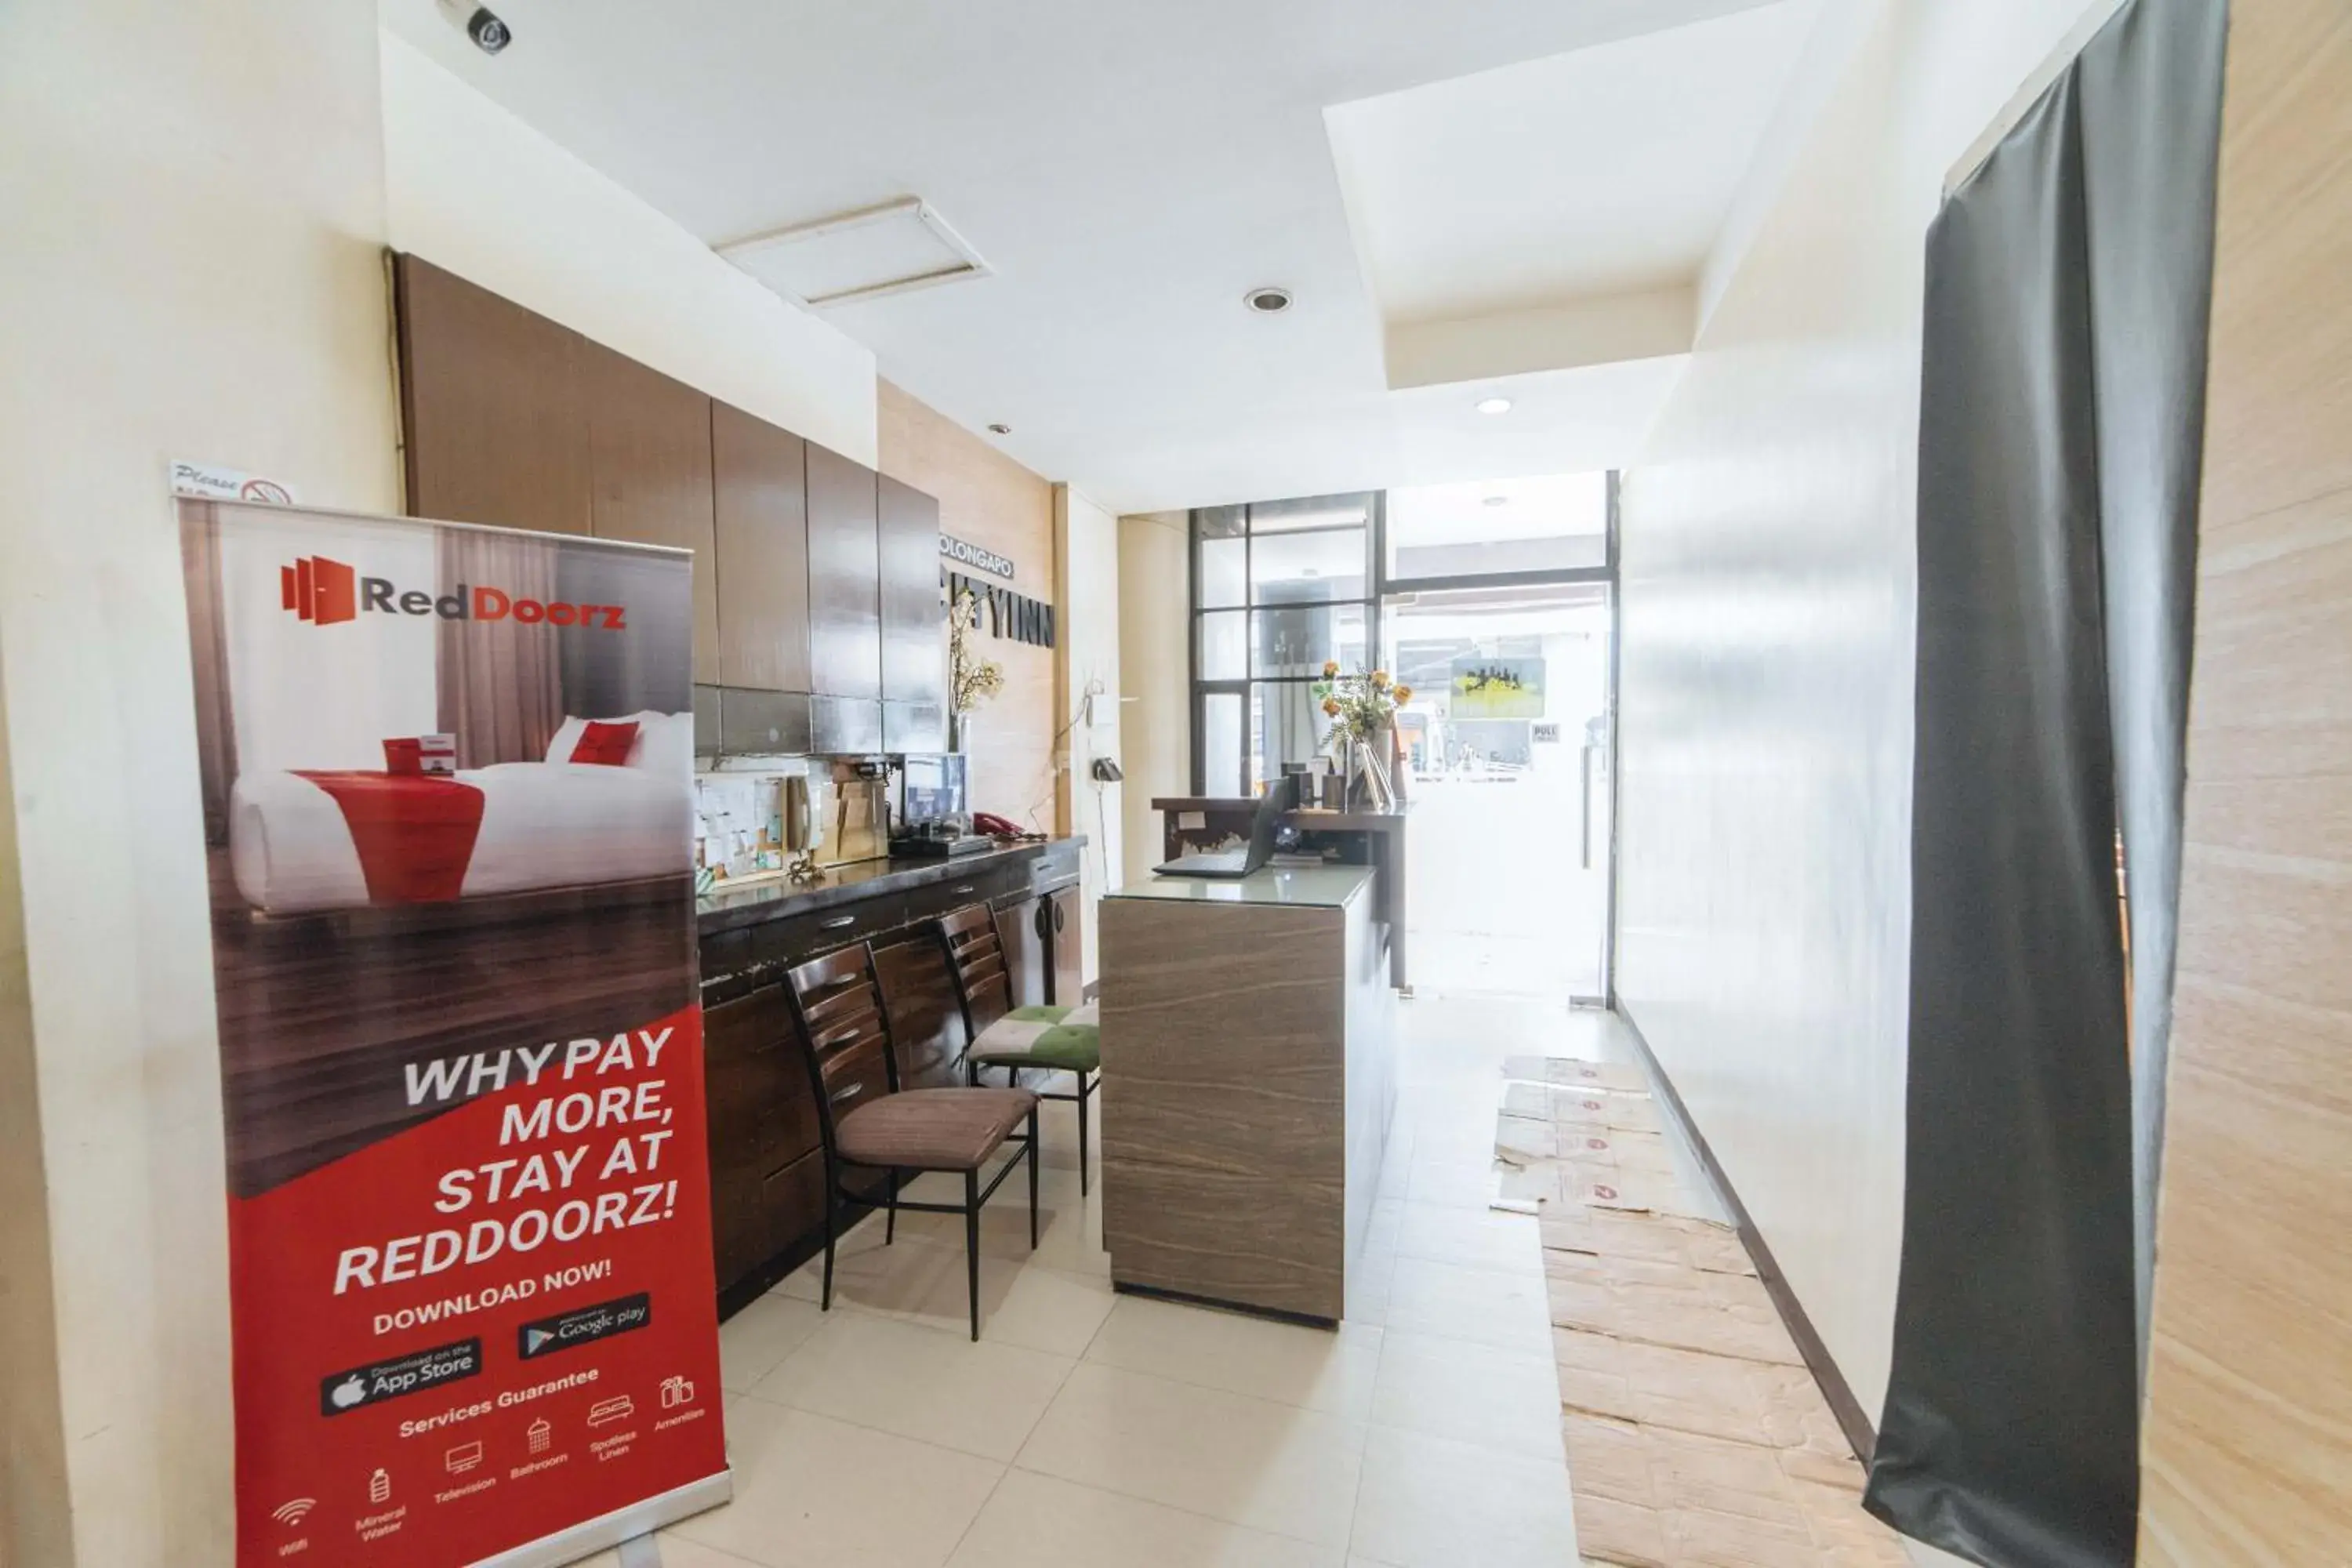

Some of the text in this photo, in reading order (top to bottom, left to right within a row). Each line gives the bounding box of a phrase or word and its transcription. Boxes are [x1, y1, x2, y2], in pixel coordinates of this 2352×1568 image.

[176, 465, 238, 489] Please
[939, 536, 1011, 576] OLONGAPO
[361, 577, 626, 630] RedDoorz
[405, 1027, 675, 1105] WHY PAY
[499, 1080, 673, 1146] MORE,
[434, 1130, 673, 1214] STAY AT
[333, 1180, 678, 1295] REDDOORZ!
[373, 1259, 612, 1335] DOWNLOAD NOW!
[559, 1315, 613, 1338] Google
[617, 1307, 645, 1327] play
[371, 1345, 472, 1377] Download on the
[372, 1356, 474, 1394] App Store
[399, 1369, 599, 1438] Services Guarantee
[655, 1408, 706, 1432] Amenities
[590, 1431, 637, 1453] Spotless
[598, 1445, 629, 1461] Linen
[510, 1453, 568, 1480] Bathroom
[434, 1477, 496, 1504] Television
[355, 1504, 406, 1530] Mineral
[361, 1521, 401, 1541] Water
